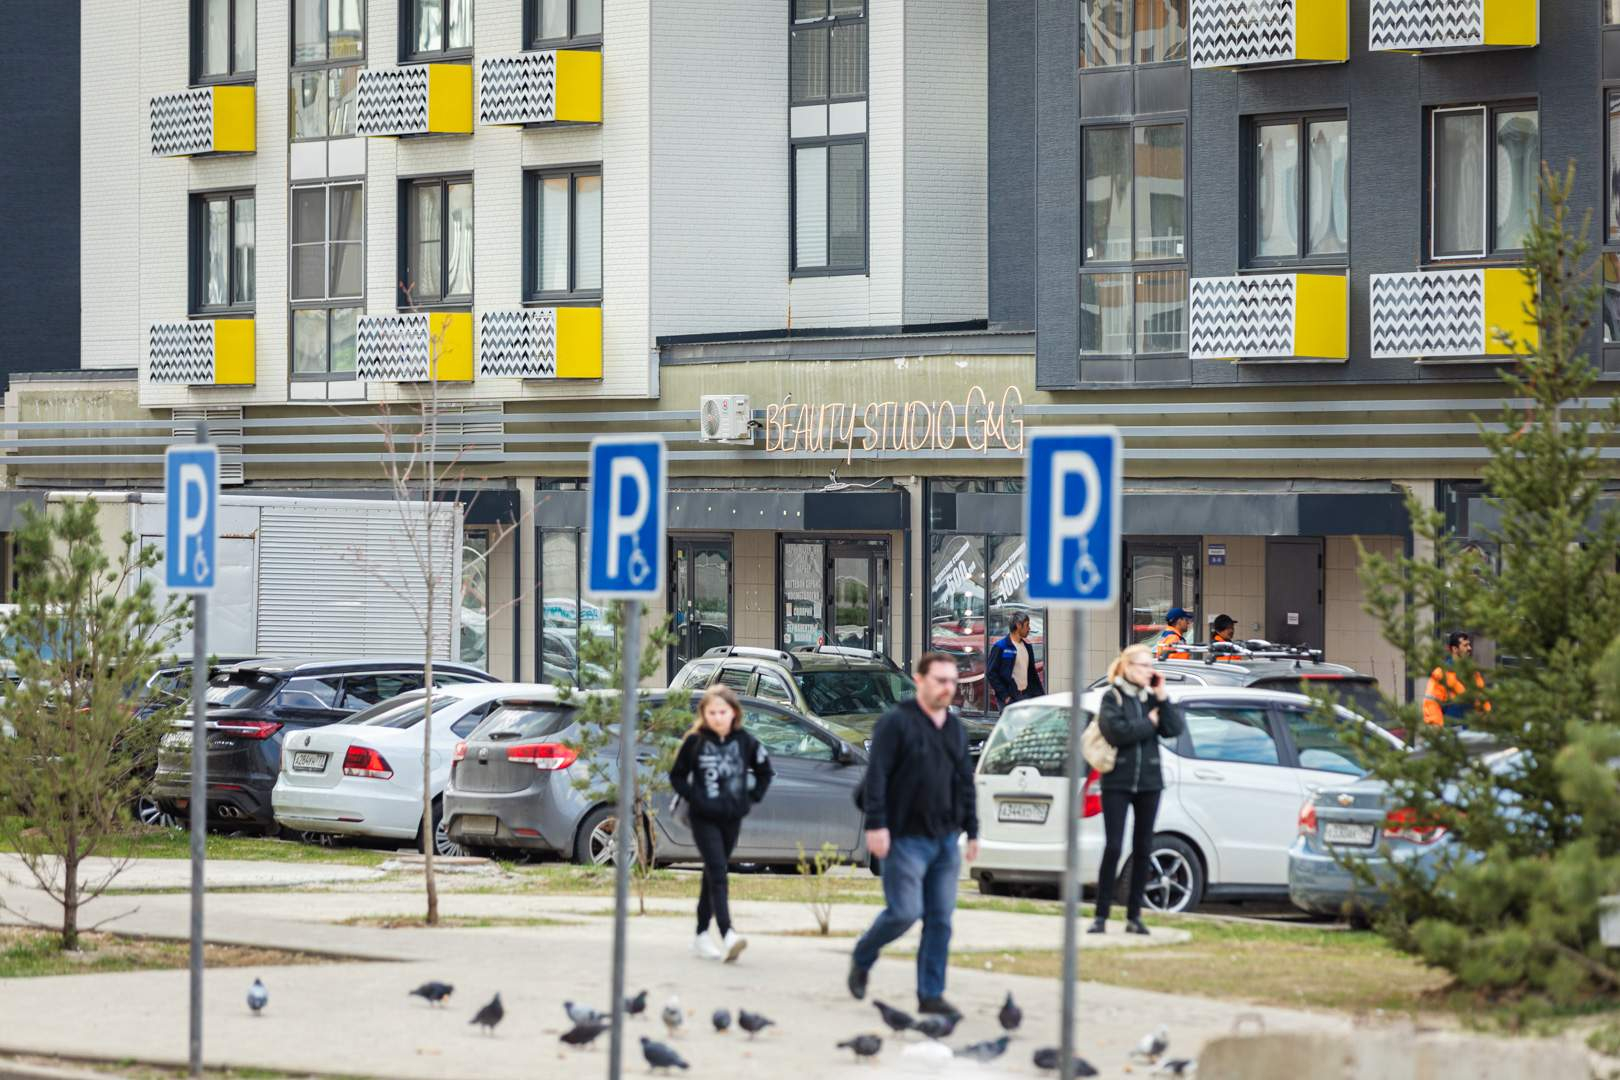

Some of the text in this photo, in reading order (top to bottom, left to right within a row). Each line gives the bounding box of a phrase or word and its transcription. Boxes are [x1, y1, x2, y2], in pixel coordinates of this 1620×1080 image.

[965, 385, 1024, 455] G&G
[178, 463, 209, 576] P
[606, 456, 650, 579] P
[1048, 451, 1101, 586] P
